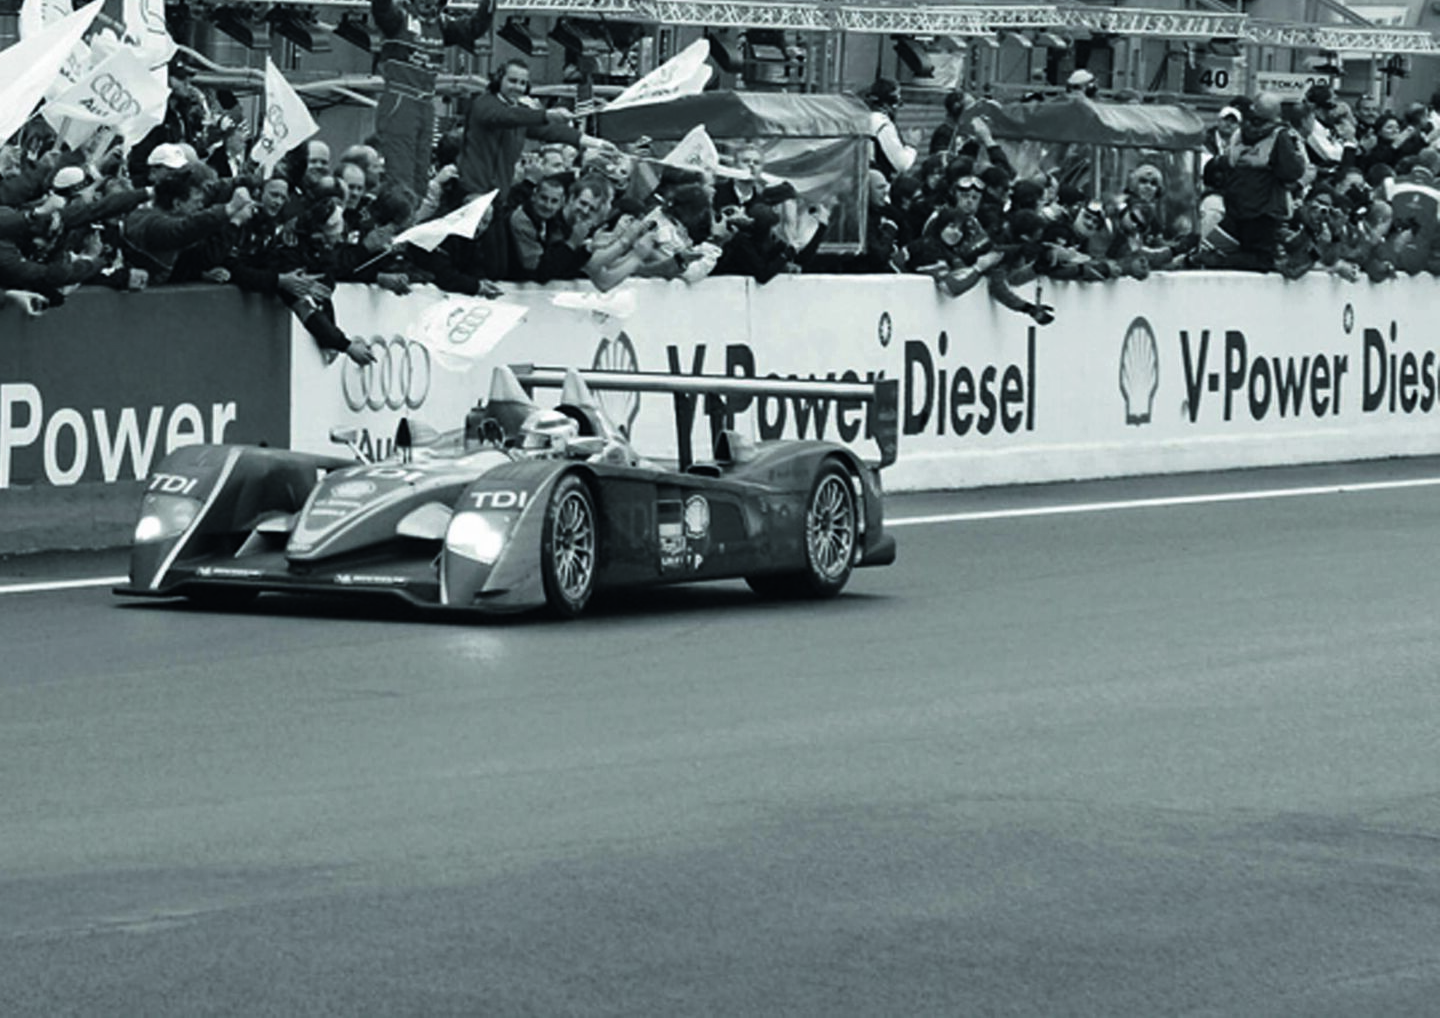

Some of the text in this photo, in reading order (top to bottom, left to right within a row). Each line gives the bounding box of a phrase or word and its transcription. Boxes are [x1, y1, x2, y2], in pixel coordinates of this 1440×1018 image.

[1199, 70, 1230, 89] 40
[902, 325, 1036, 436] Diesel
[1178, 320, 1440, 423] V-Power Dies
[149, 472, 198, 495] TDI
[470, 490, 528, 509] TDI
